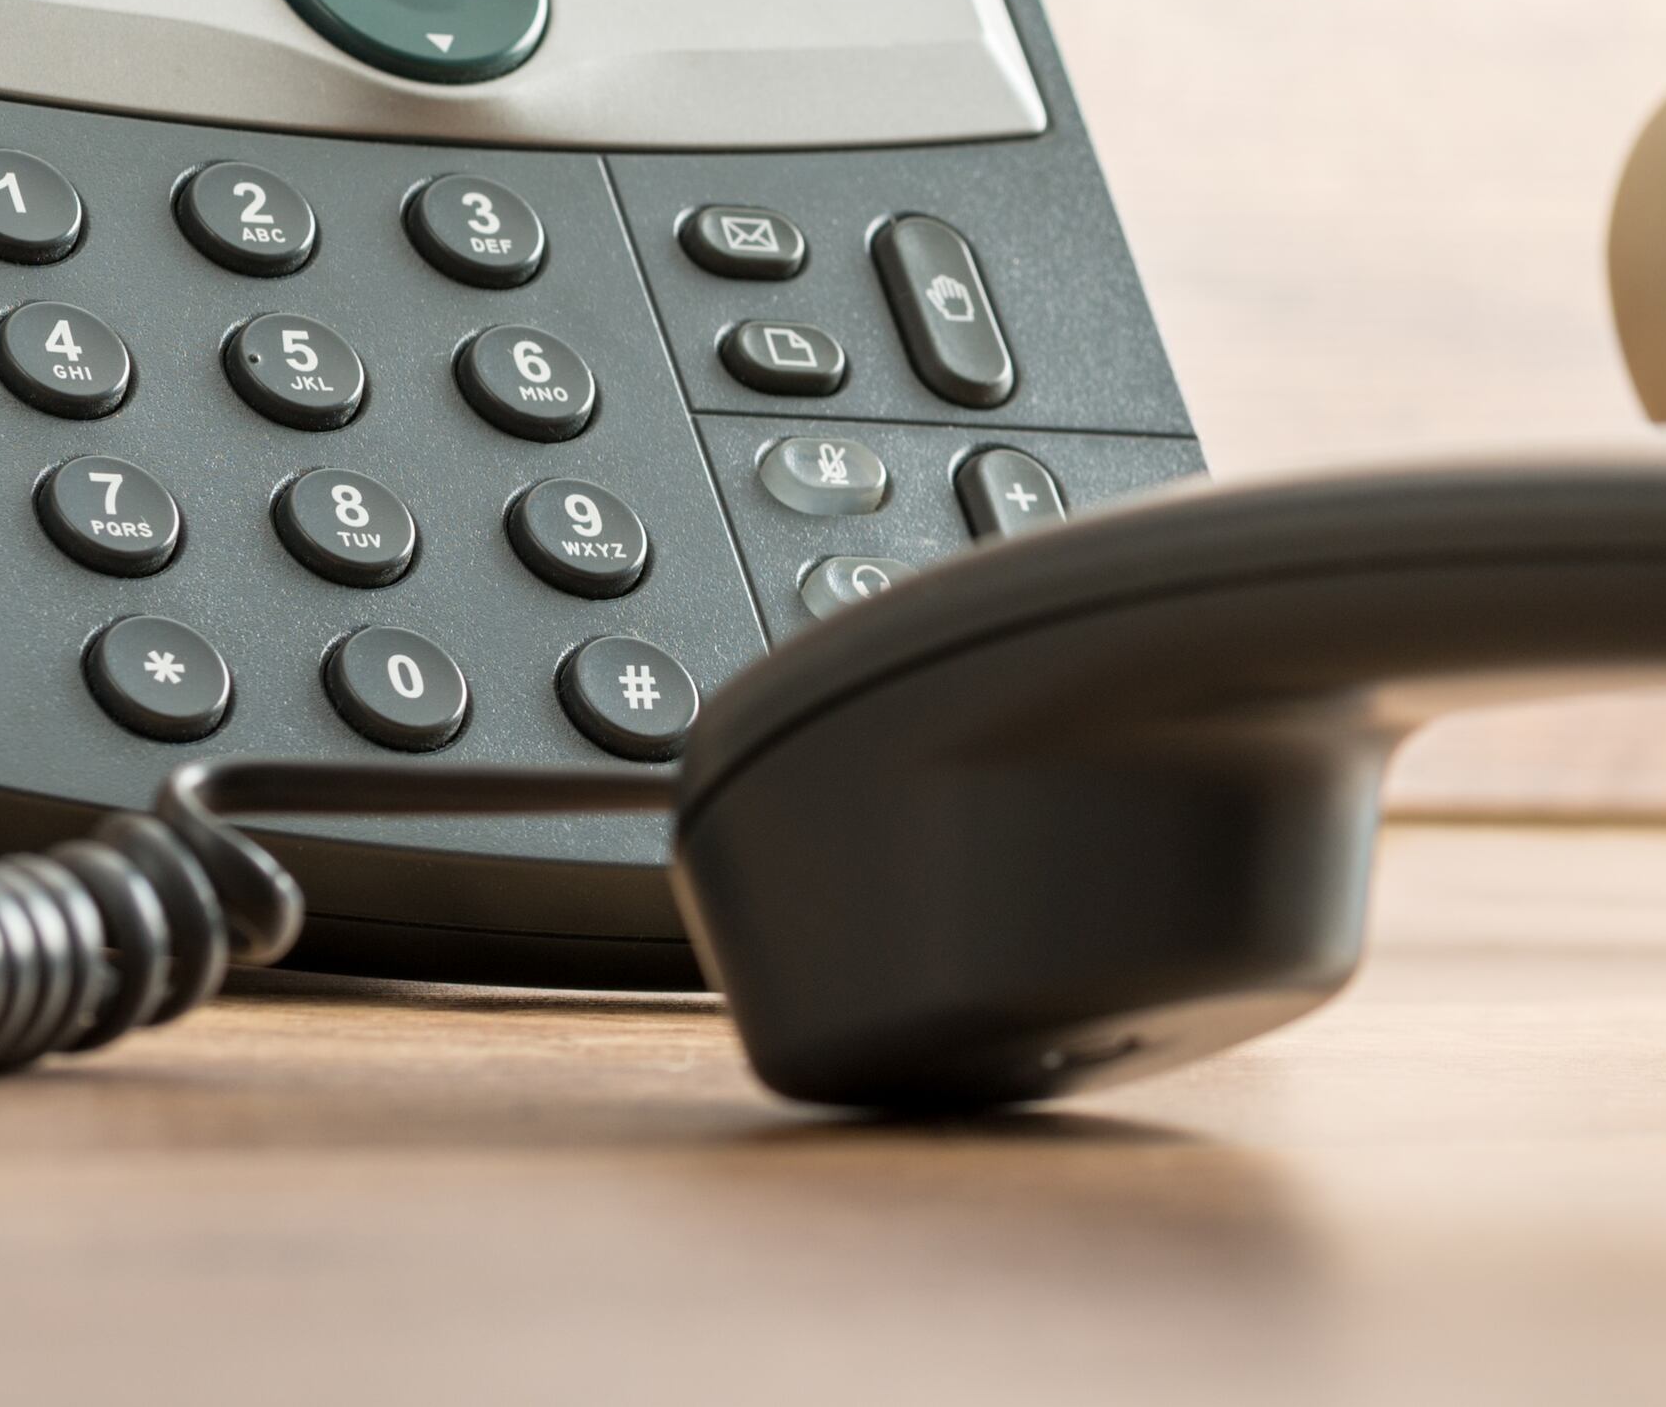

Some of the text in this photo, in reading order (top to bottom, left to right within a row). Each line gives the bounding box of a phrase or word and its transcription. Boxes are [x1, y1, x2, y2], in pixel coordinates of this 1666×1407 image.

[233, 182, 274, 224] 2
[462, 192, 501, 235] 3
[242, 227, 286, 243] ABC
[470, 237, 512, 254] DEF
[44, 319, 83, 362] 4
[282, 329, 319, 372] 5
[513, 340, 552, 383] 6
[52, 364, 93, 381] GHI
[290, 375, 334, 392] JKL
[519, 386, 569, 402] MNO
[88, 472, 123, 515] 7
[331, 484, 370, 528] 8
[90, 519, 153, 538] PQRS
[564, 494, 603, 537] 9
[336, 531, 381, 548] TUV
[561, 540, 627, 558] WXYZ
[387, 654, 424, 699] 0
